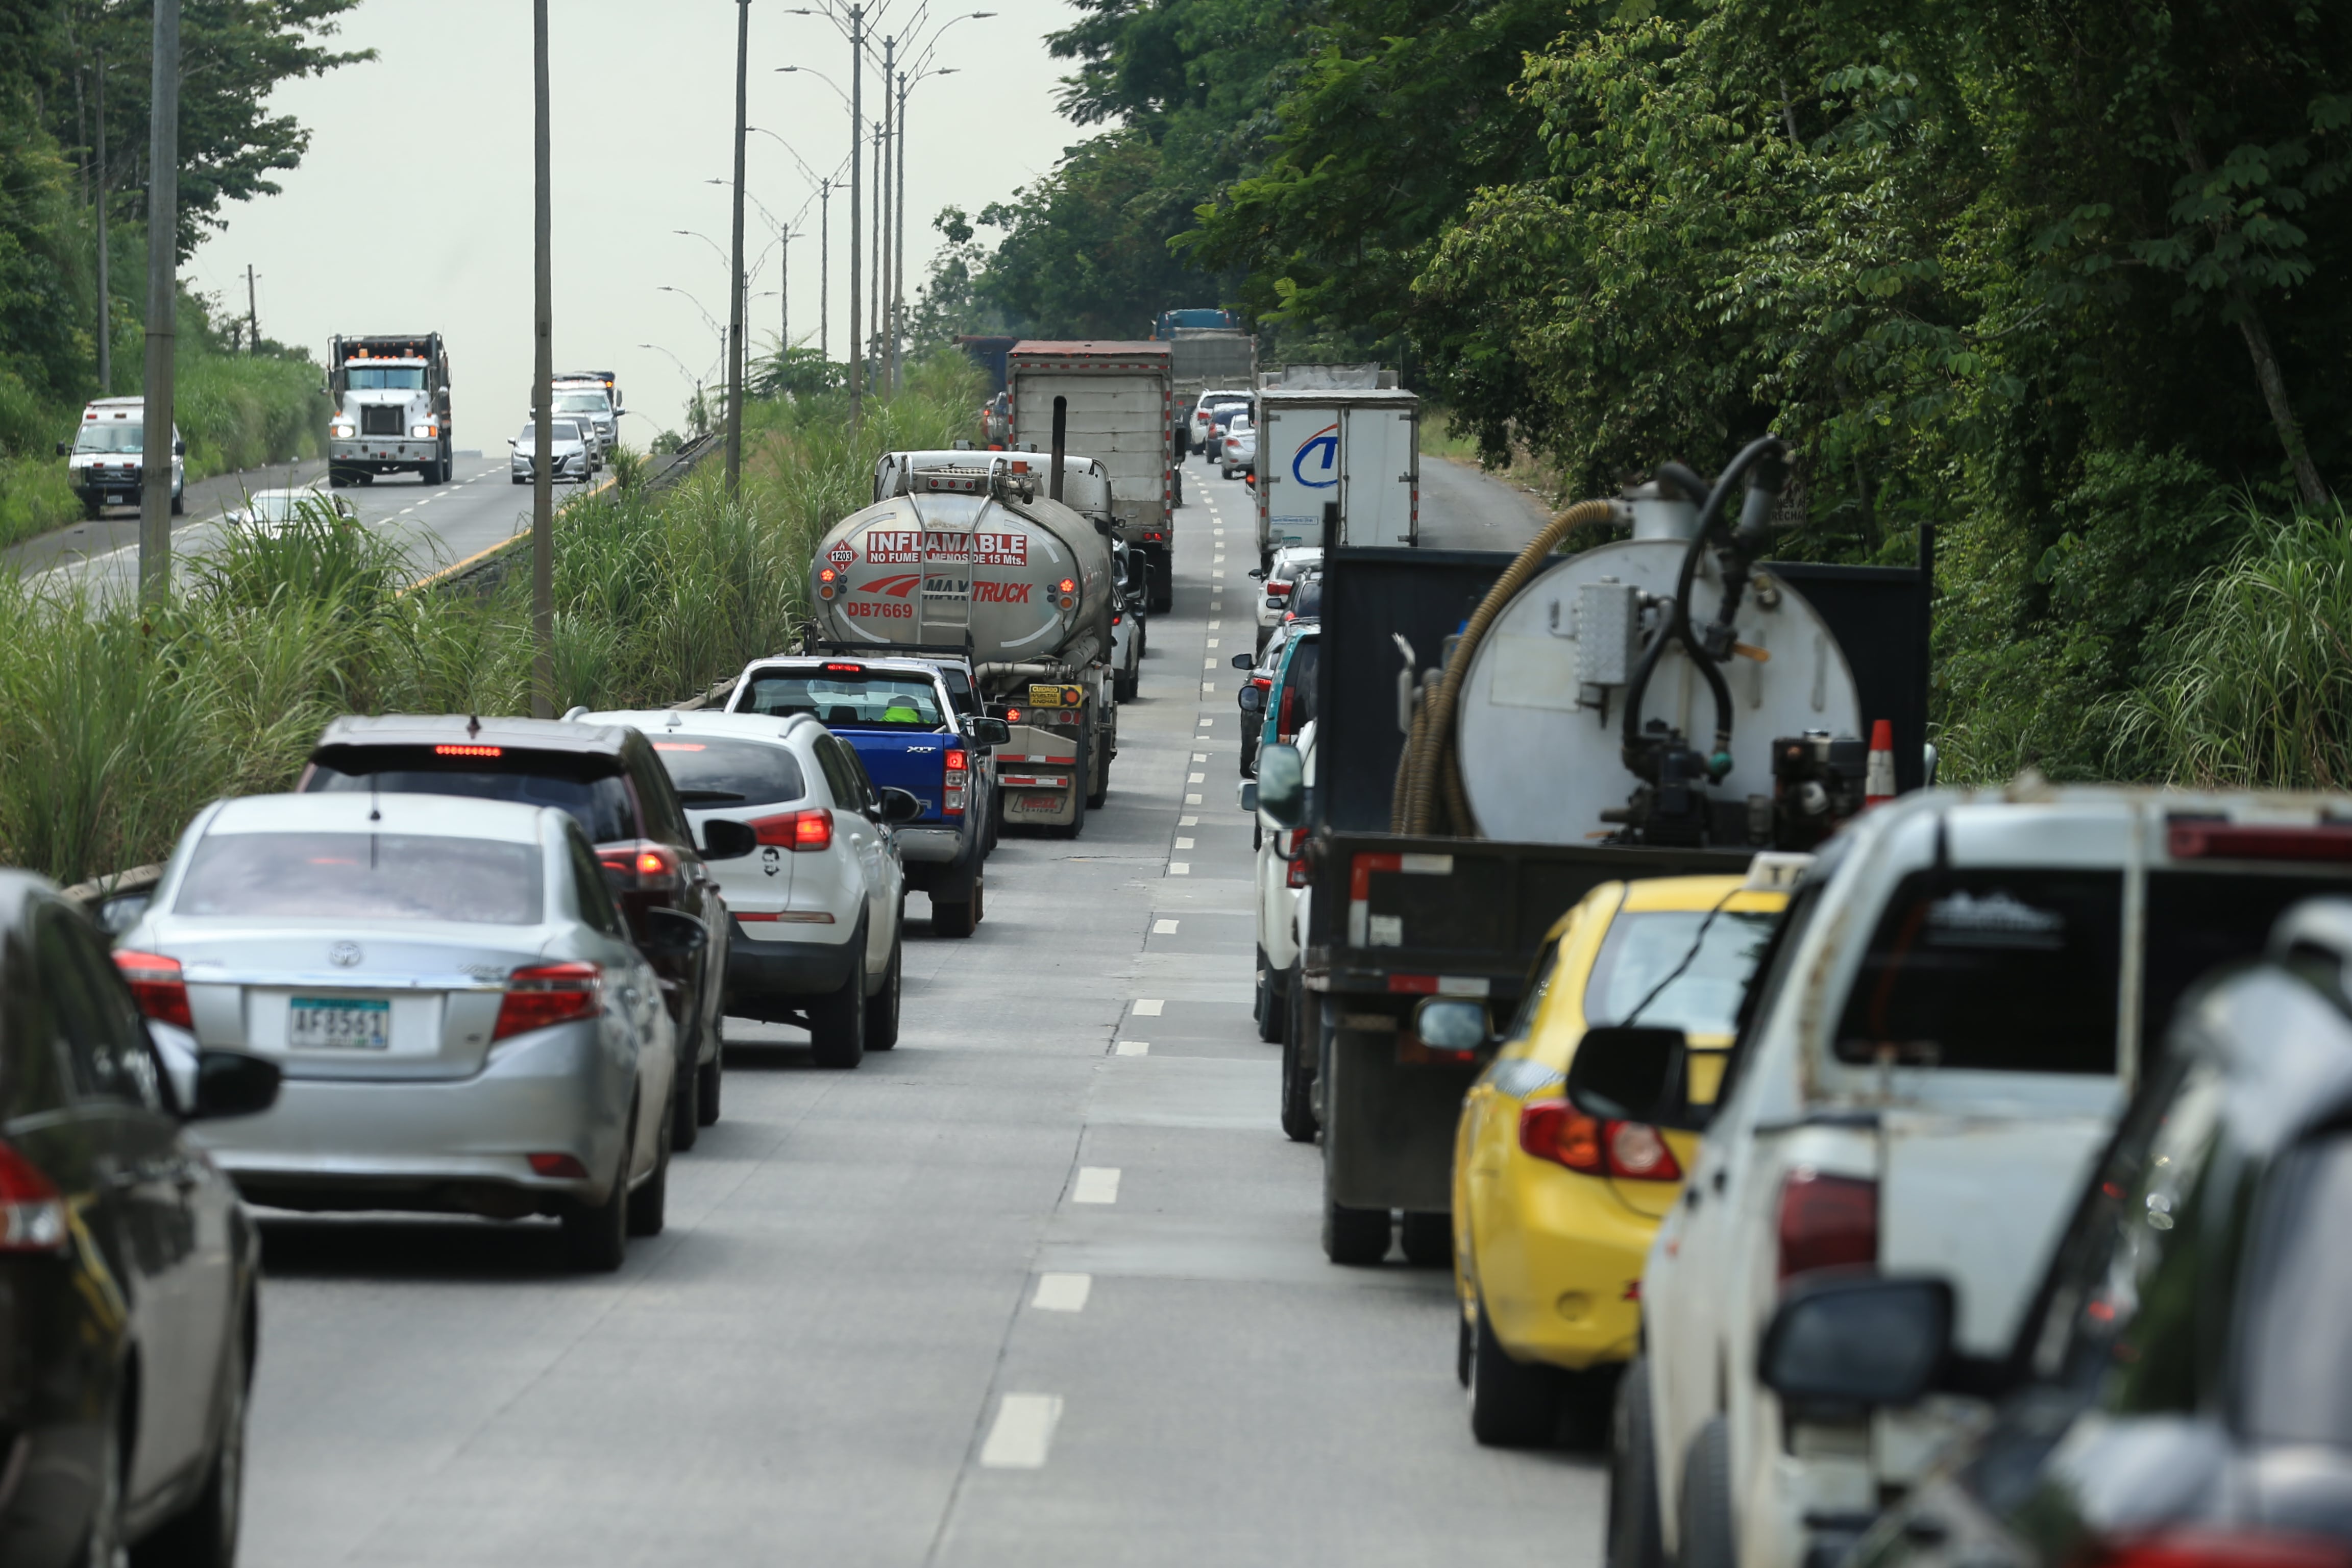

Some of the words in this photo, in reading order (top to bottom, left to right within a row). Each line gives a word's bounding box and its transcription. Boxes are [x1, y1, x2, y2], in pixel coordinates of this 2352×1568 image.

[1771, 511, 1804, 521] RECHA
[870, 533, 1024, 554] INFLAMABLE
[832, 552, 851, 561] 1203
[870, 552, 886, 562] NO
[889, 553, 919, 562] FUME
[932, 552, 968, 562] MENOS
[988, 554, 1000, 564] 15
[1003, 554, 1025, 566] Mts.
[847, 602, 913, 618] DB7669
